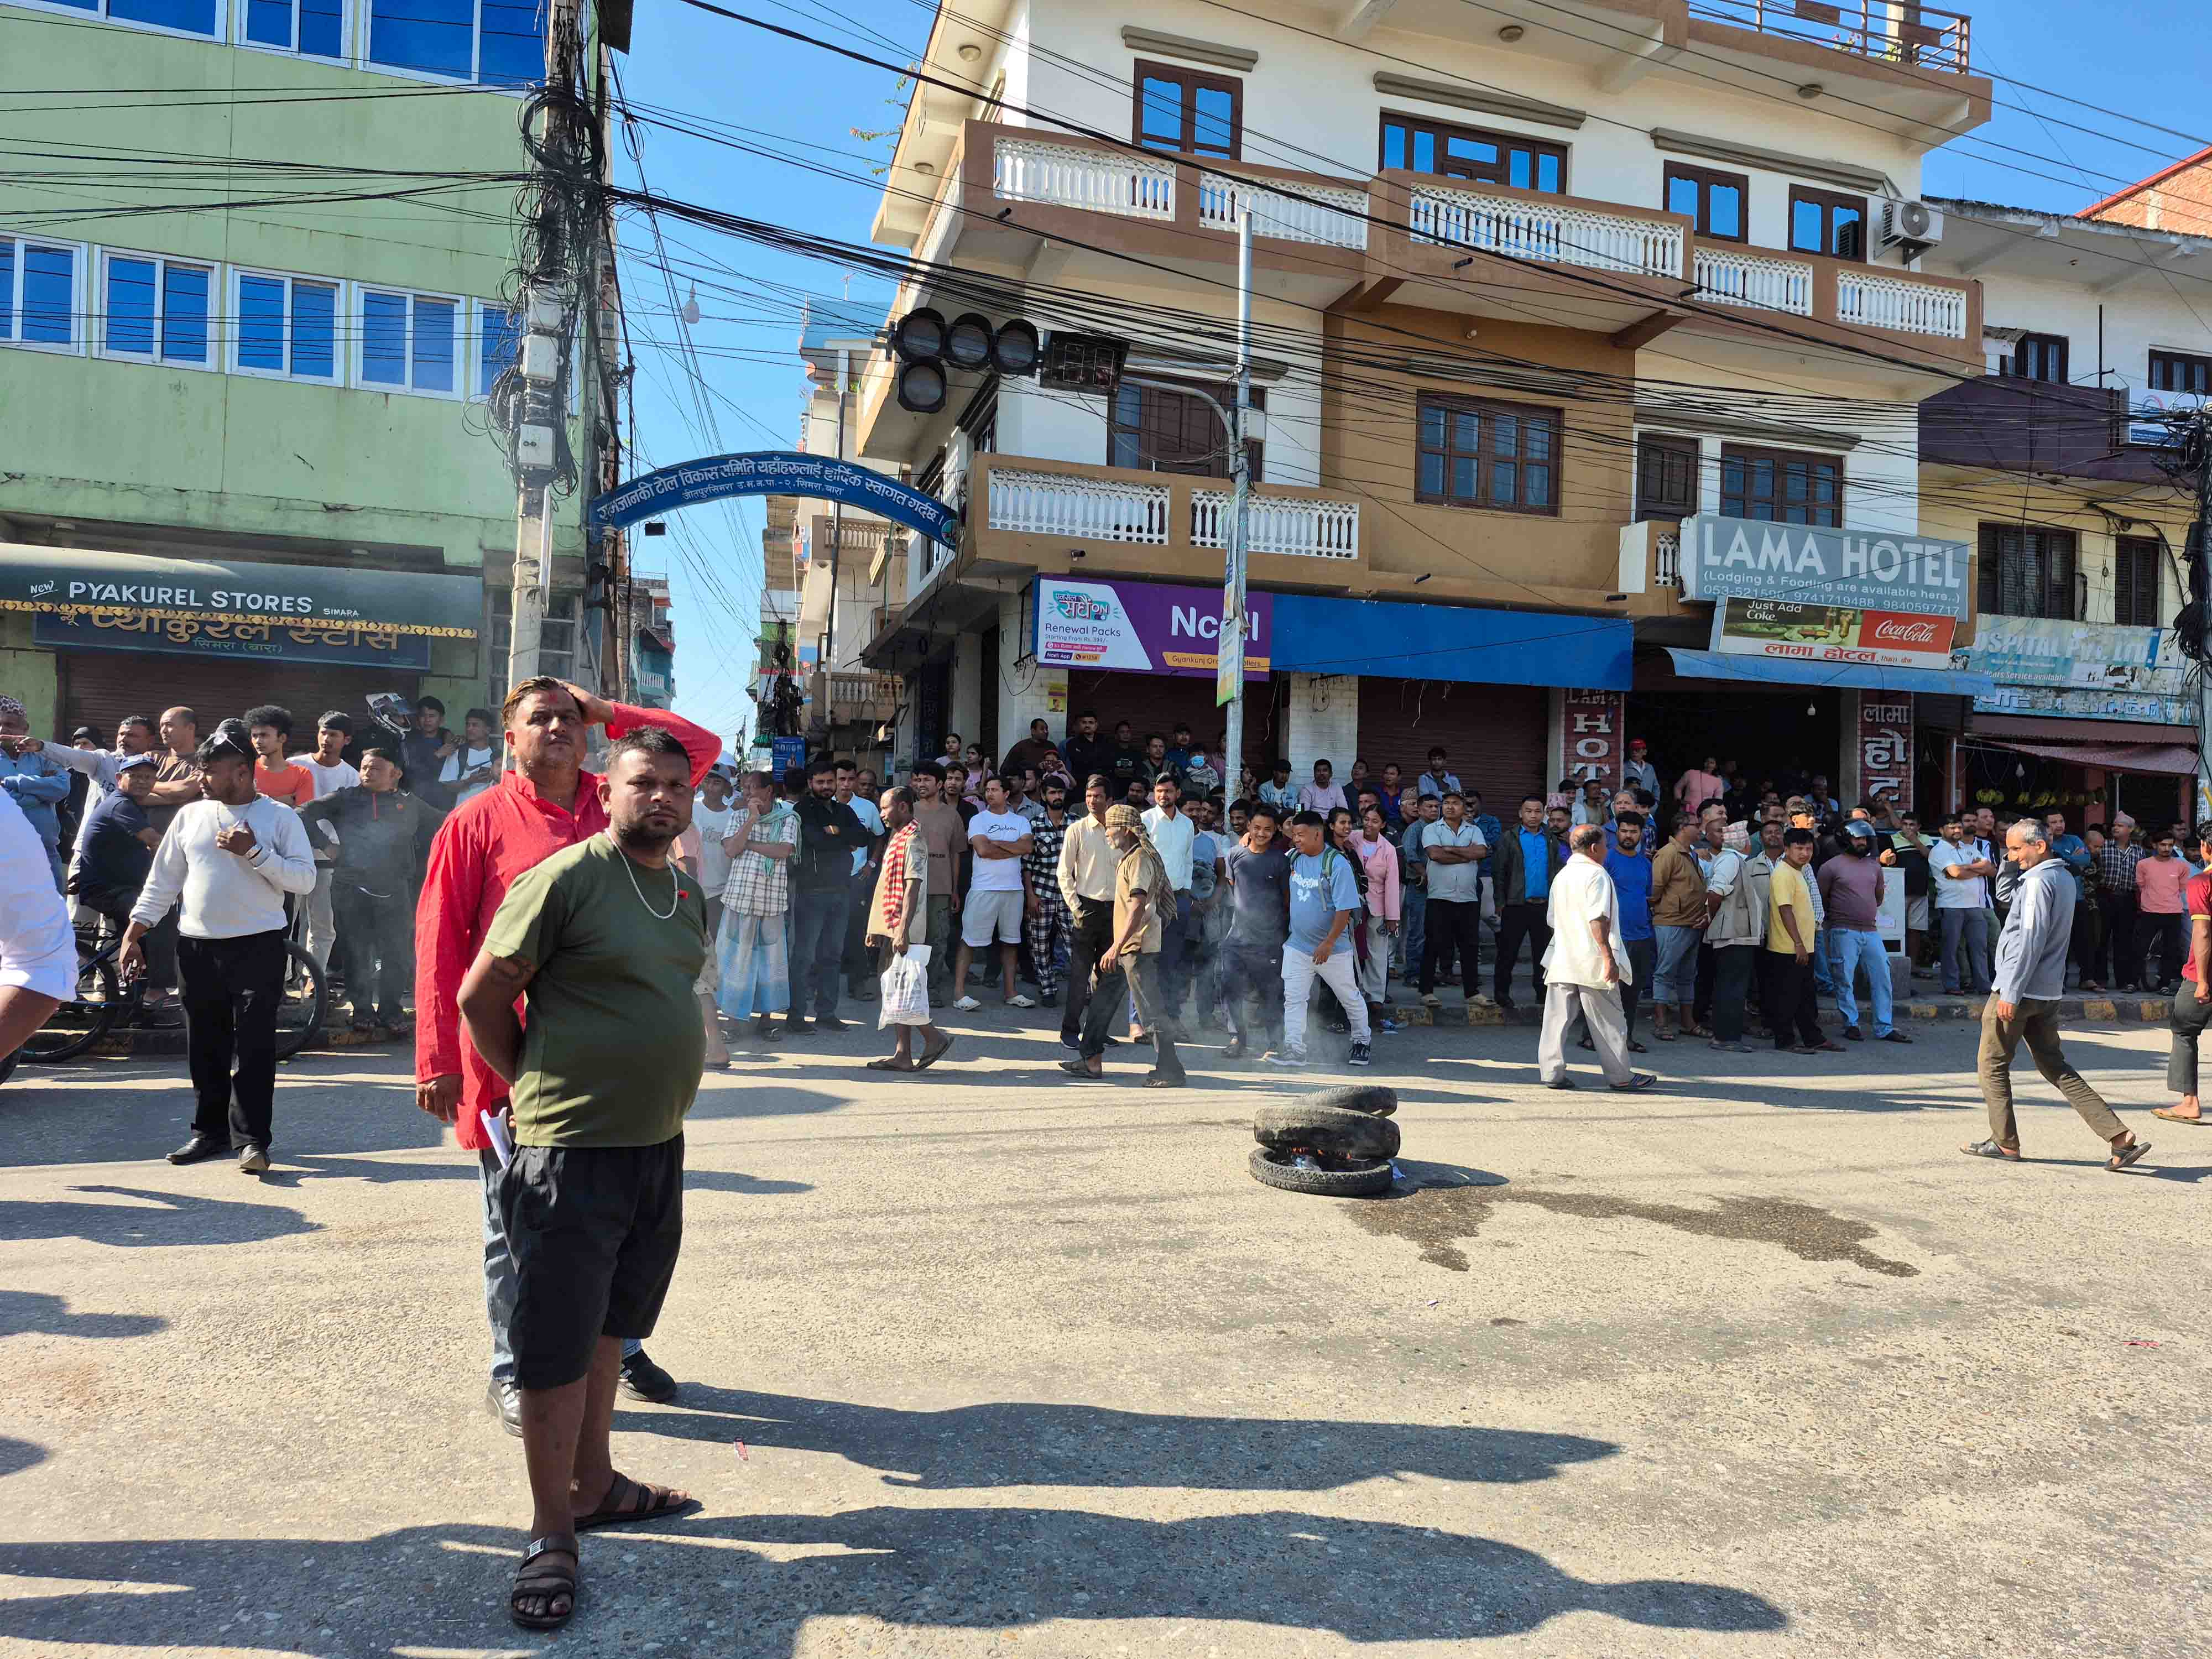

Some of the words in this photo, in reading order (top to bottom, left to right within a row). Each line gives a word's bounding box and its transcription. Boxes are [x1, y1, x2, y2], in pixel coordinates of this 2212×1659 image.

[654, 476, 679, 494] टोल
[679, 466, 719, 487] विकास
[865, 477, 910, 507] स्वागत
[1704, 523, 1827, 576] LAMA
[1841, 536, 1961, 588] HOTEL
[1766, 575, 1775, 585] &
[1781, 576, 1833, 593] Fooding
[1837, 585, 1857, 593] are
[1861, 586, 1917, 598] available
[30, 581, 54, 594] New
[69, 582, 203, 607] PYAKUREL
[211, 590, 314, 613] STORES
[323, 608, 360, 618] SIMARA
[1748, 601, 1774, 611] Just
[1777, 603, 1802, 613] Add
[1045, 623, 1088, 634] Renewal
[1092, 627, 1121, 637] Packs
[1171, 605, 1259, 641] Ncl
[1765, 643, 1815, 656] लामा
[1864, 704, 1910, 724] लामा
